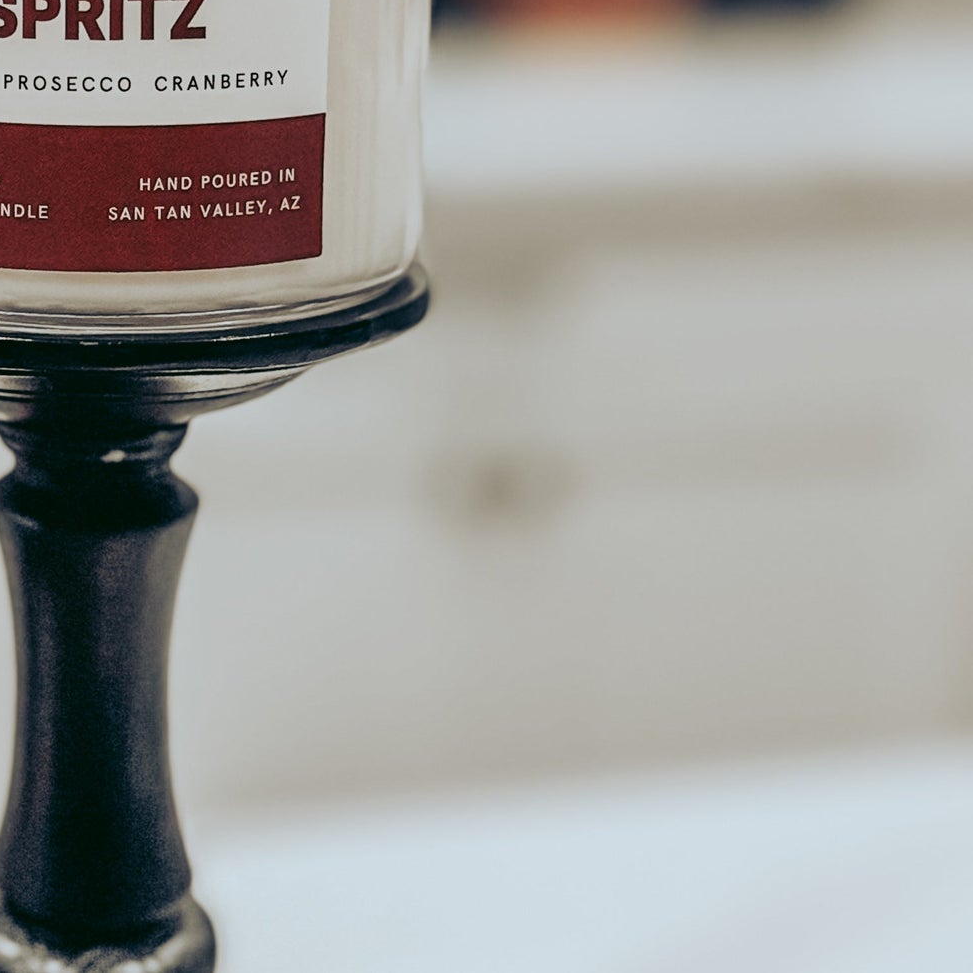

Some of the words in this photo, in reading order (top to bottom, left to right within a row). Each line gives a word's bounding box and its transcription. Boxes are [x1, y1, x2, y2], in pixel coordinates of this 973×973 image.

[3, 74, 132, 93] PROSECCO
[154, 69, 288, 92] CRANBERRY
[139, 176, 192, 191] HAND
[201, 170, 272, 189] POURED
[279, 168, 295, 183] IN
[108, 206, 145, 221] SAN
[153, 204, 191, 220] TAN
[200, 199, 273, 218] VALLEY,
[279, 195, 301, 211] AZ
